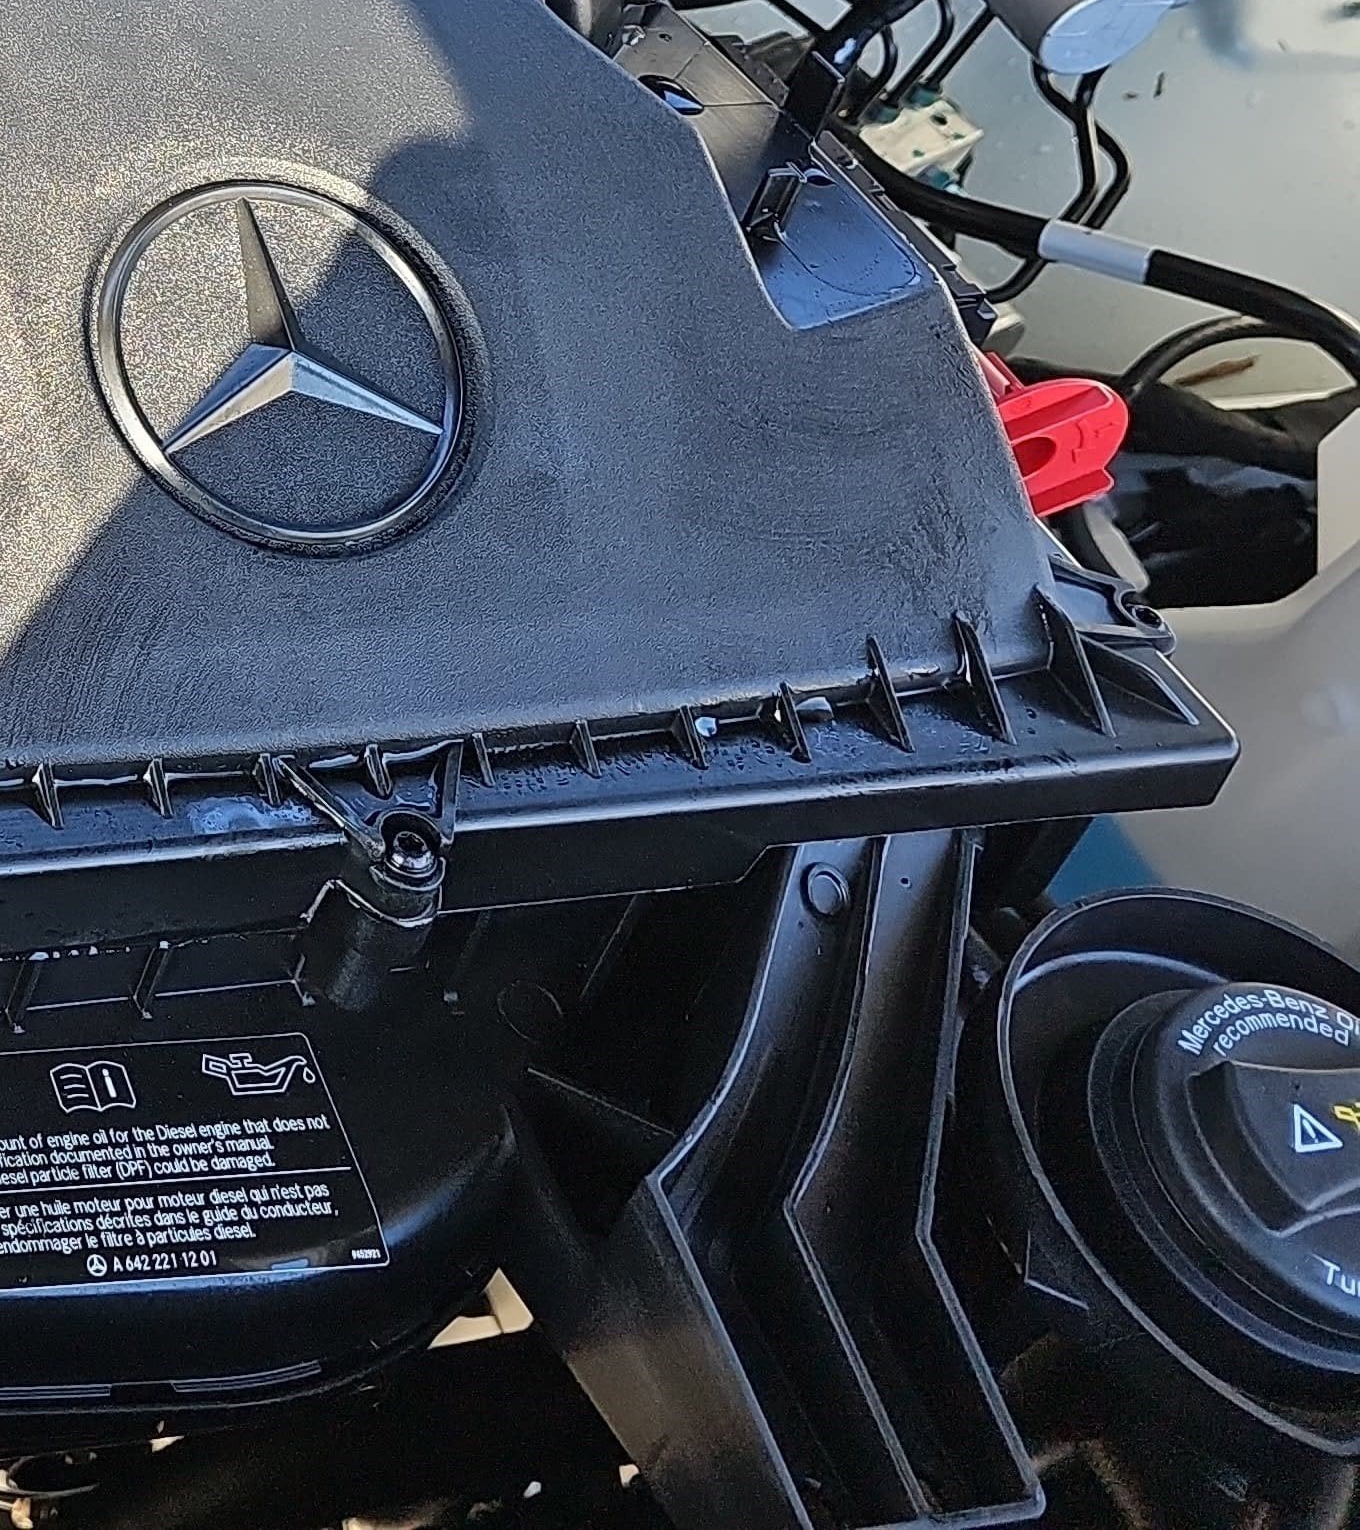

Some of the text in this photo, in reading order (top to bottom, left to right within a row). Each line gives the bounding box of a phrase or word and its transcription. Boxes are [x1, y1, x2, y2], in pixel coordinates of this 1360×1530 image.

[1178, 989, 1330, 1056] Mercedes-Benz
[1212, 1011, 1351, 1057] recommended
[29, 1133, 43, 1150] of
[47, 1131, 90, 1151] engine
[93, 1129, 108, 1144] oil
[109, 1127, 129, 1143] for
[132, 1126, 155, 1141] the
[155, 1123, 196, 1140] Diesel
[198, 1121, 241, 1140] engine
[243, 1118, 270, 1134] that
[272, 1116, 305, 1132] does
[306, 1114, 331, 1130] not
[50, 1143, 133, 1166] documented
[135, 1143, 146, 1158] in
[147, 1142, 171, 1157] the
[172, 1138, 224, 1156] owner's
[225, 1135, 275, 1152] manual.
[30, 1167, 79, 1186] particle
[82, 1164, 113, 1180] filter
[116, 1160, 152, 1179] (DPF)
[154, 1157, 189, 1174] could
[189, 1156, 208, 1171] be
[211, 1152, 275, 1171] damaged.
[15, 1203, 39, 1218] une
[41, 1199, 71, 1217] huile
[73, 1198, 121, 1214] moteur
[124, 1194, 154, 1216] pour
[158, 1191, 206, 1208] moteur
[208, 1187, 247, 1205] diesel
[249, 1186, 268, 1204] qui
[272, 1184, 304, 1201] n'est
[306, 1184, 330, 1203] pas
[2, 1215, 94, 1238] spécifications
[96, 1210, 150, 1230] décrites
[154, 1209, 187, 1226] dans
[188, 1208, 200, 1224] le
[202, 1205, 239, 1225] guide
[241, 1204, 259, 1219] du
[85, 1233, 98, 1249] le
[100, 1230, 132, 1247] filtre
[134, 1228, 147, 1246] à
[148, 1225, 211, 1247] particules
[214, 1222, 256, 1241] diesel.
[113, 1250, 217, 1272] A 642 221 12 01
